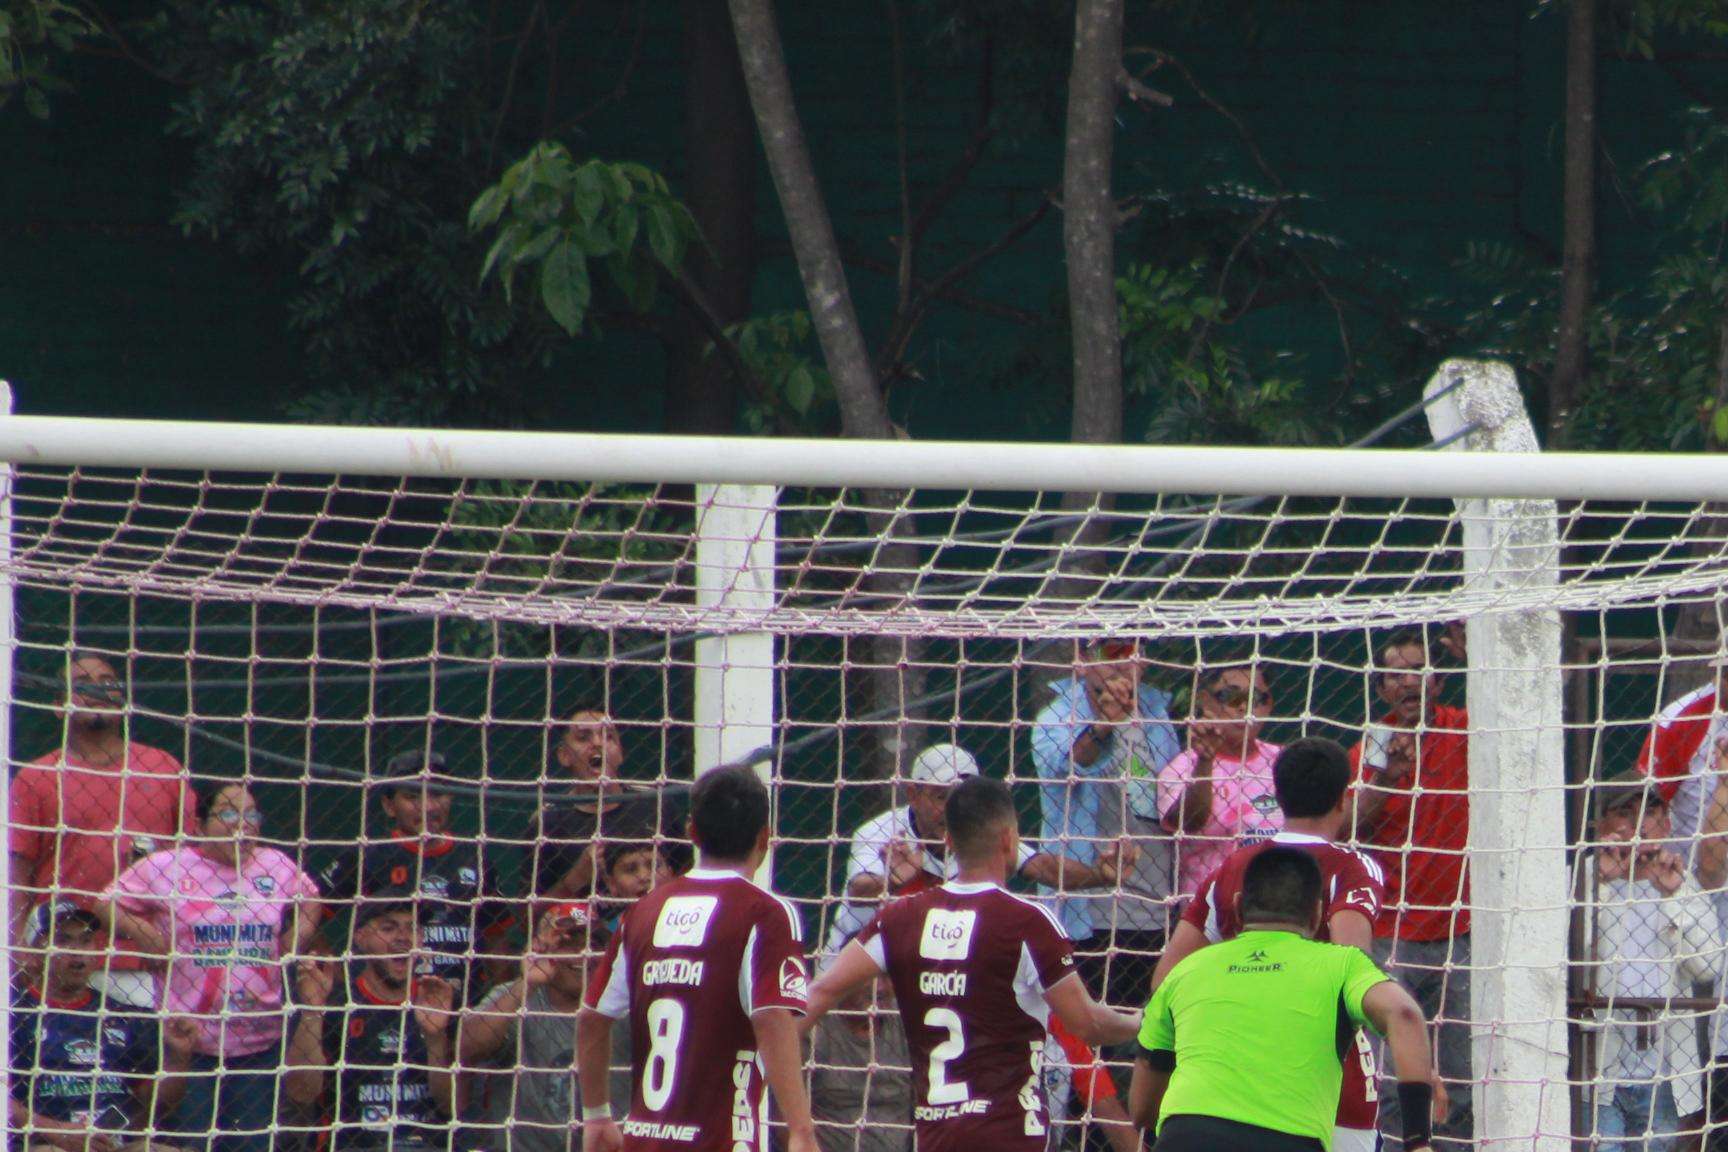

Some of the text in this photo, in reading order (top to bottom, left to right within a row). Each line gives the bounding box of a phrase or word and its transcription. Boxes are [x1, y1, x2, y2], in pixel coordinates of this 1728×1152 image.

[642, 998, 684, 1112] 8
[923, 1007, 969, 1106] 2
[1355, 1028, 1378, 1102] PEP
